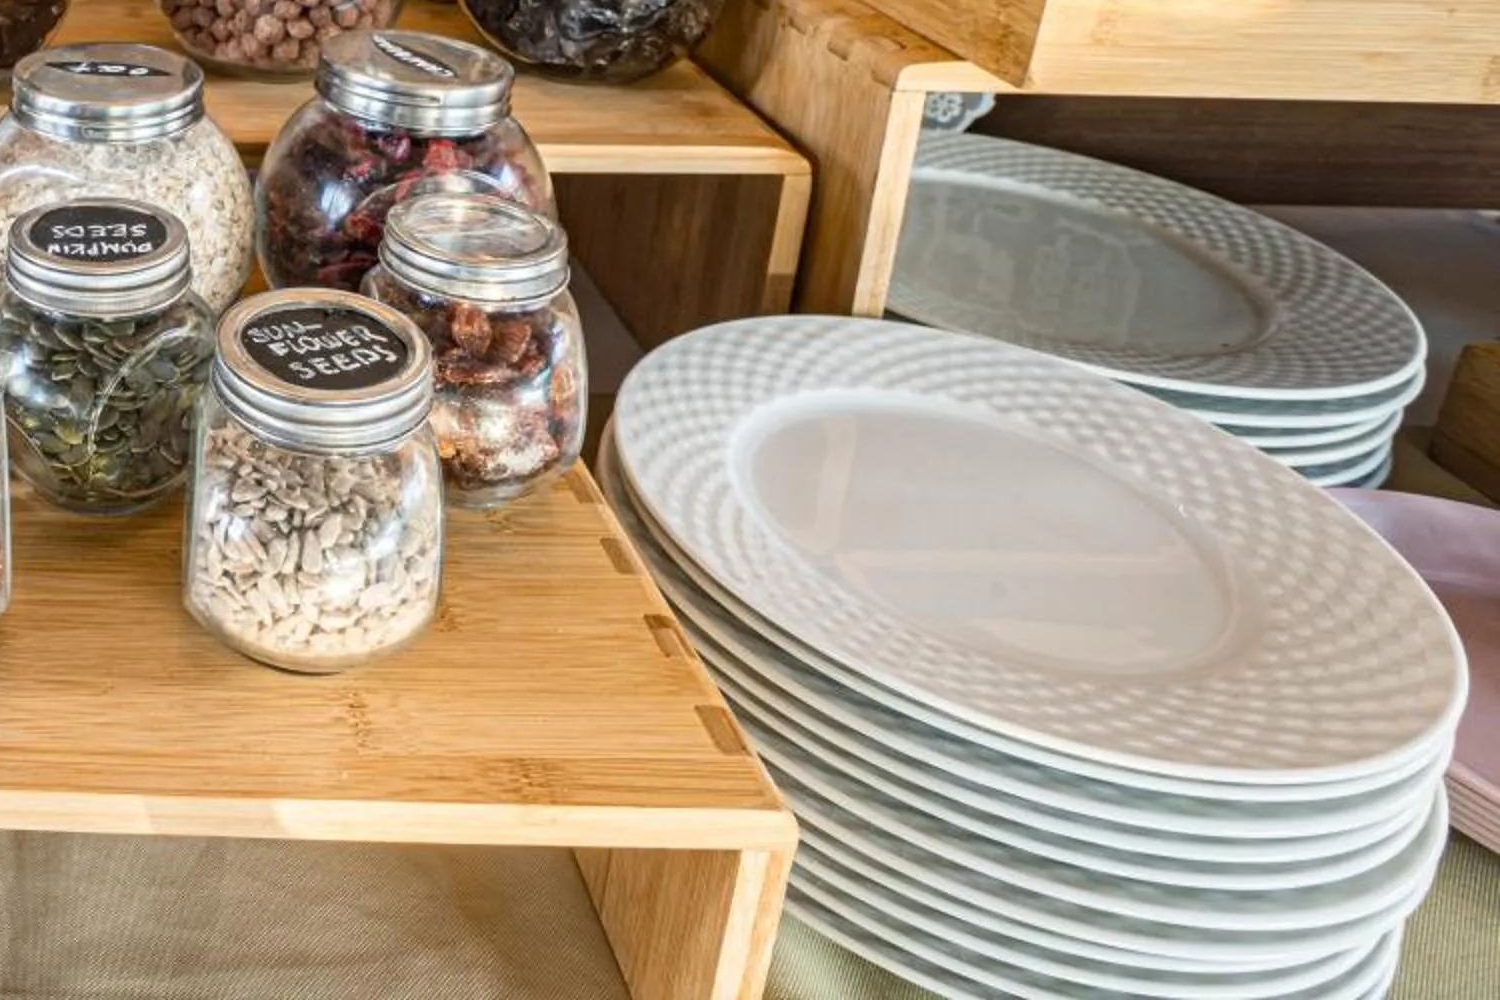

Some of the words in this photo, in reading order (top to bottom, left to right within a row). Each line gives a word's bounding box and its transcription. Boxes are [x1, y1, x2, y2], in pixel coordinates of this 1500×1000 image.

[51, 223, 148, 239] SEEDS
[47, 240, 153, 257] PUMPKIN
[267, 325, 388, 357] FLOWER
[288, 344, 399, 380] SEEDS
